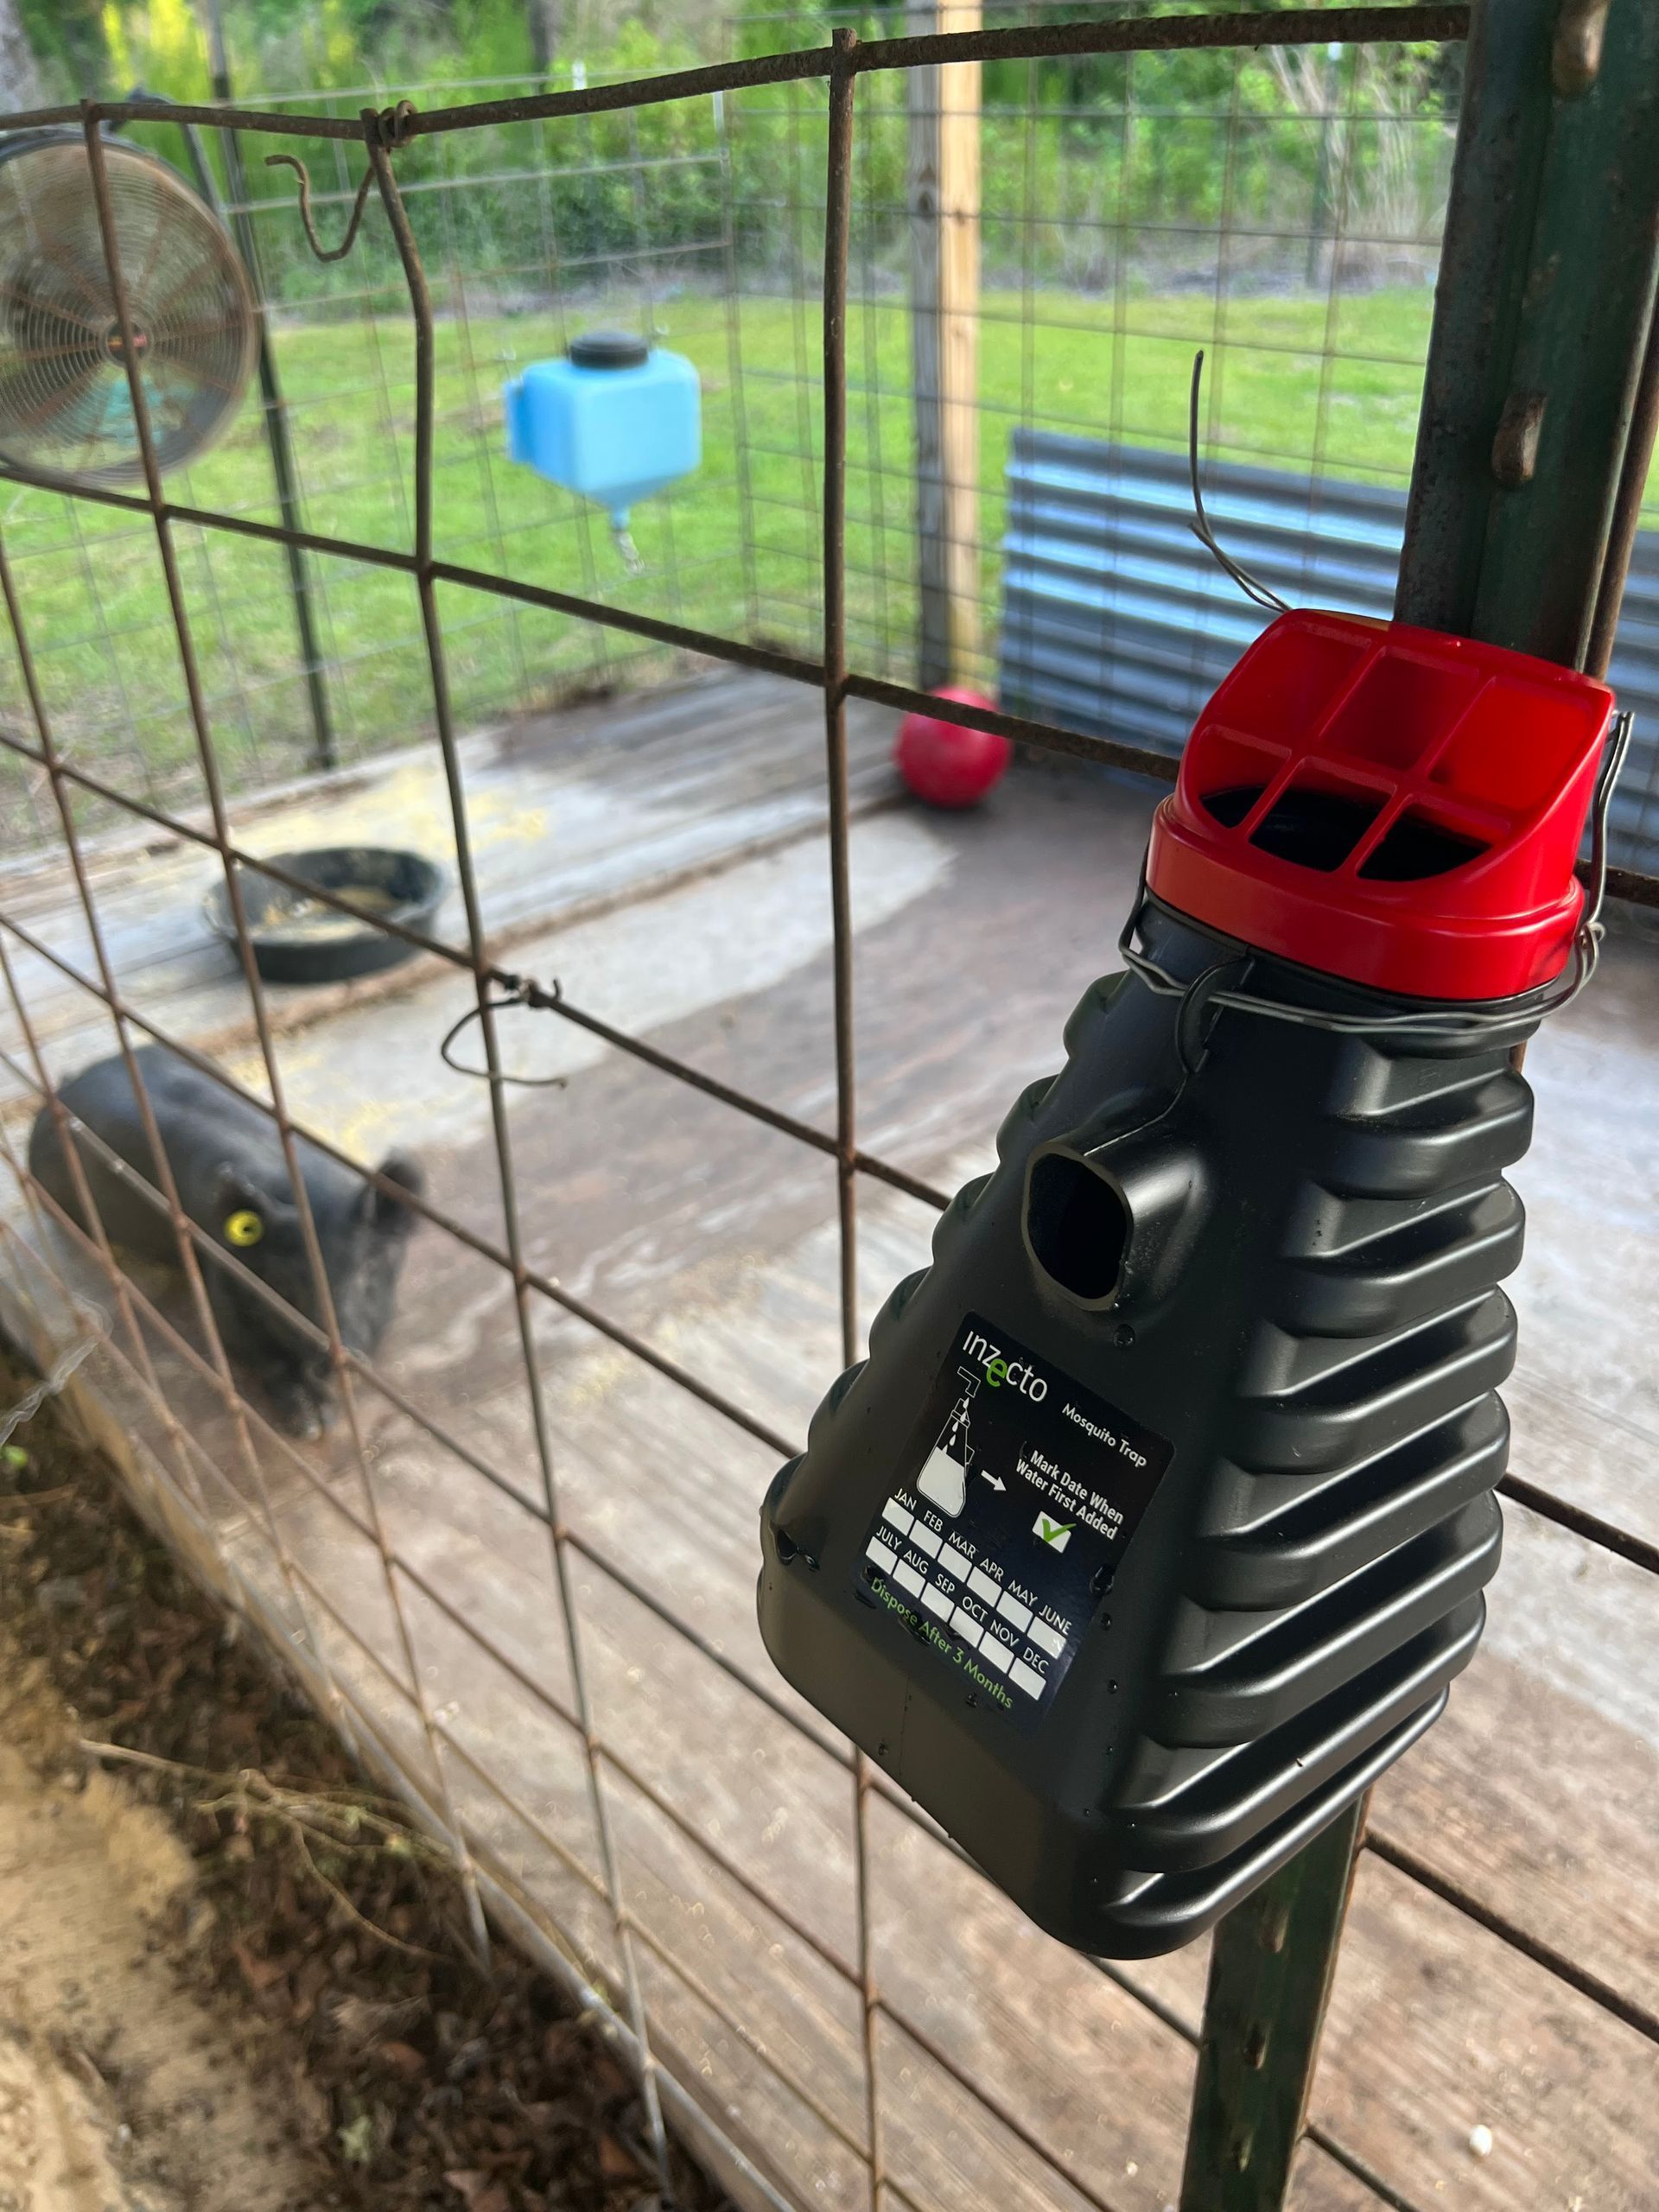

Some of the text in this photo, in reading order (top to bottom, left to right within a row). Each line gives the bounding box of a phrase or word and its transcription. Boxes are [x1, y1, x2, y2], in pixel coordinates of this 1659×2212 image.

[1030, 1450, 1124, 1525] Mark Date When
[1062, 1402, 1147, 1468] Mosquito Trap
[1015, 1459, 1119, 1540] Water First Added
[876, 1526, 1049, 1674] JULY AUG SEP OCT NOV DEC
[893, 1488, 1072, 1636] JAN FEB MAR APR MAY JUNE
[870, 1578, 1014, 1708] Dispose After 3 Months
